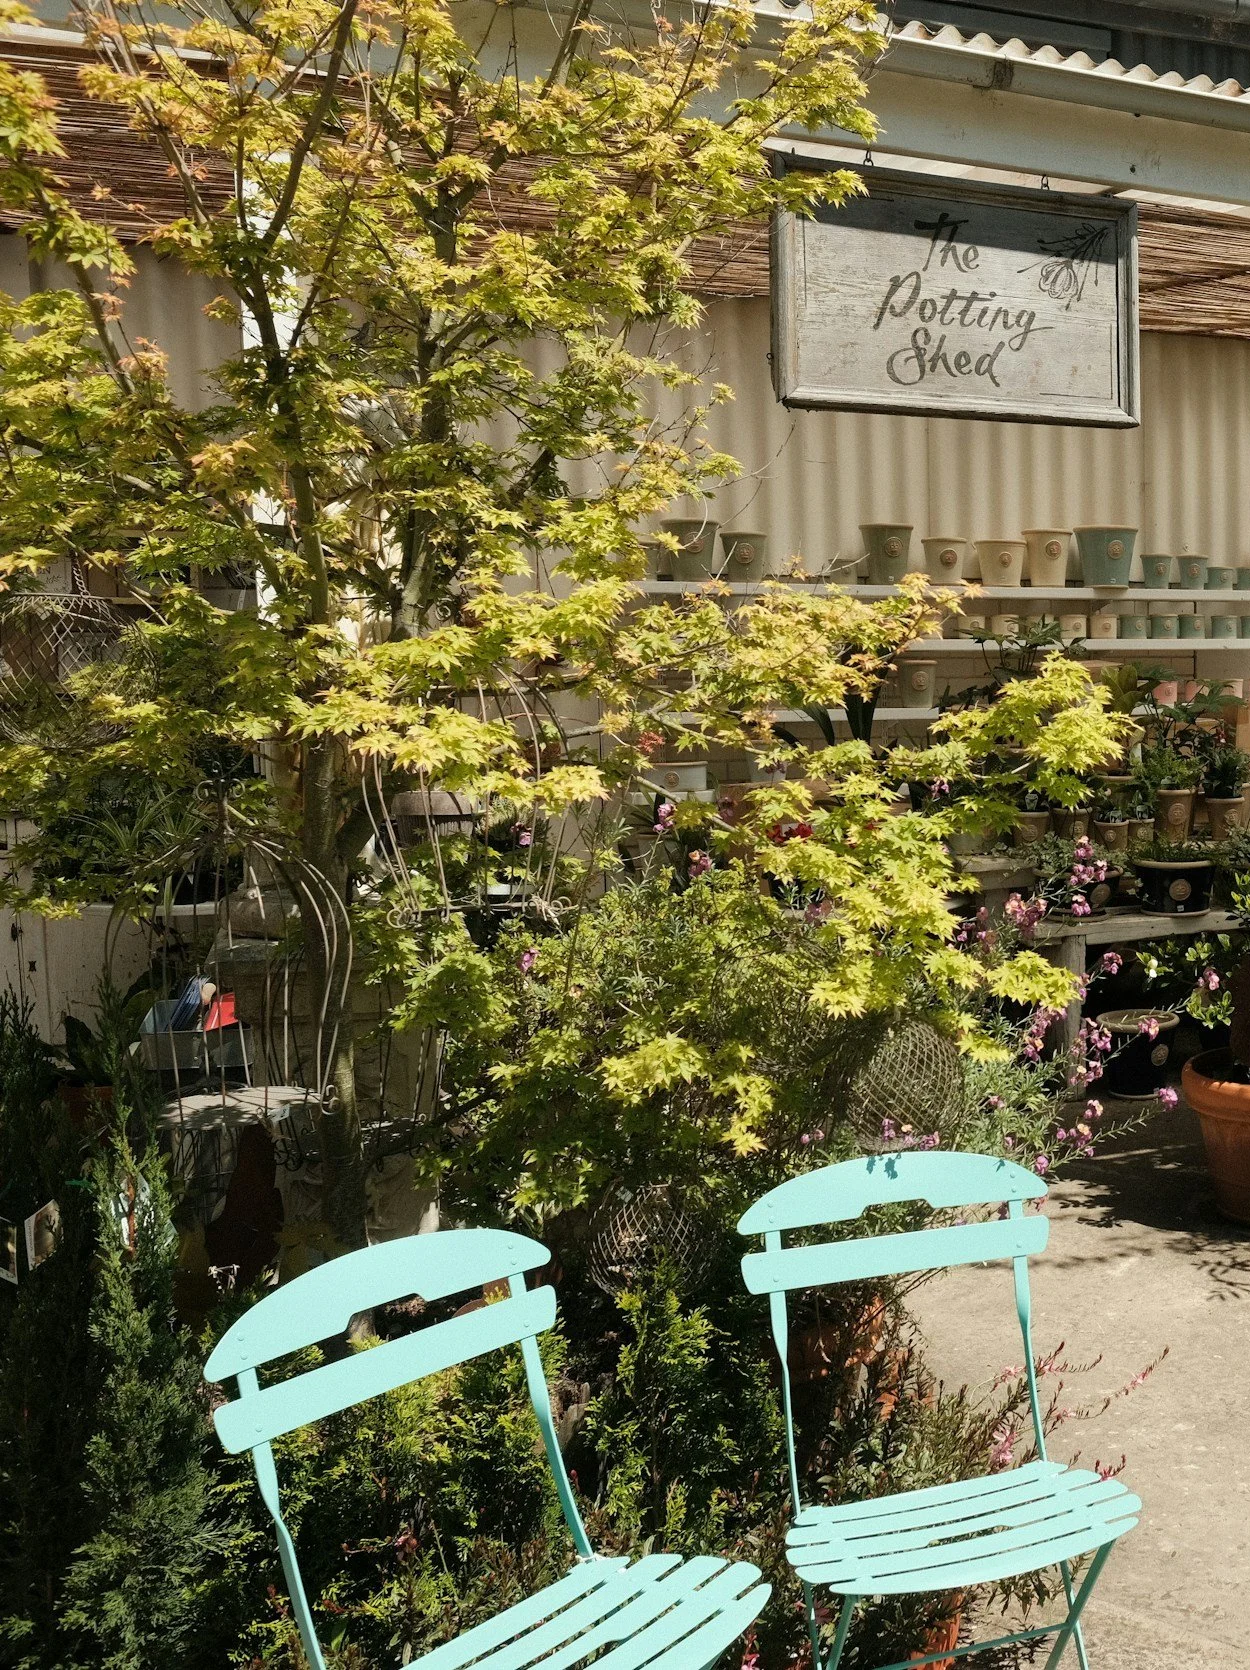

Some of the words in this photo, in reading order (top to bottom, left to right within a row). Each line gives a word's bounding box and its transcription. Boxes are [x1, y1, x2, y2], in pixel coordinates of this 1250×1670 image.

[914, 212, 980, 273] The
[873, 271, 1055, 351] Potting
[886, 326, 1005, 387] Shed
